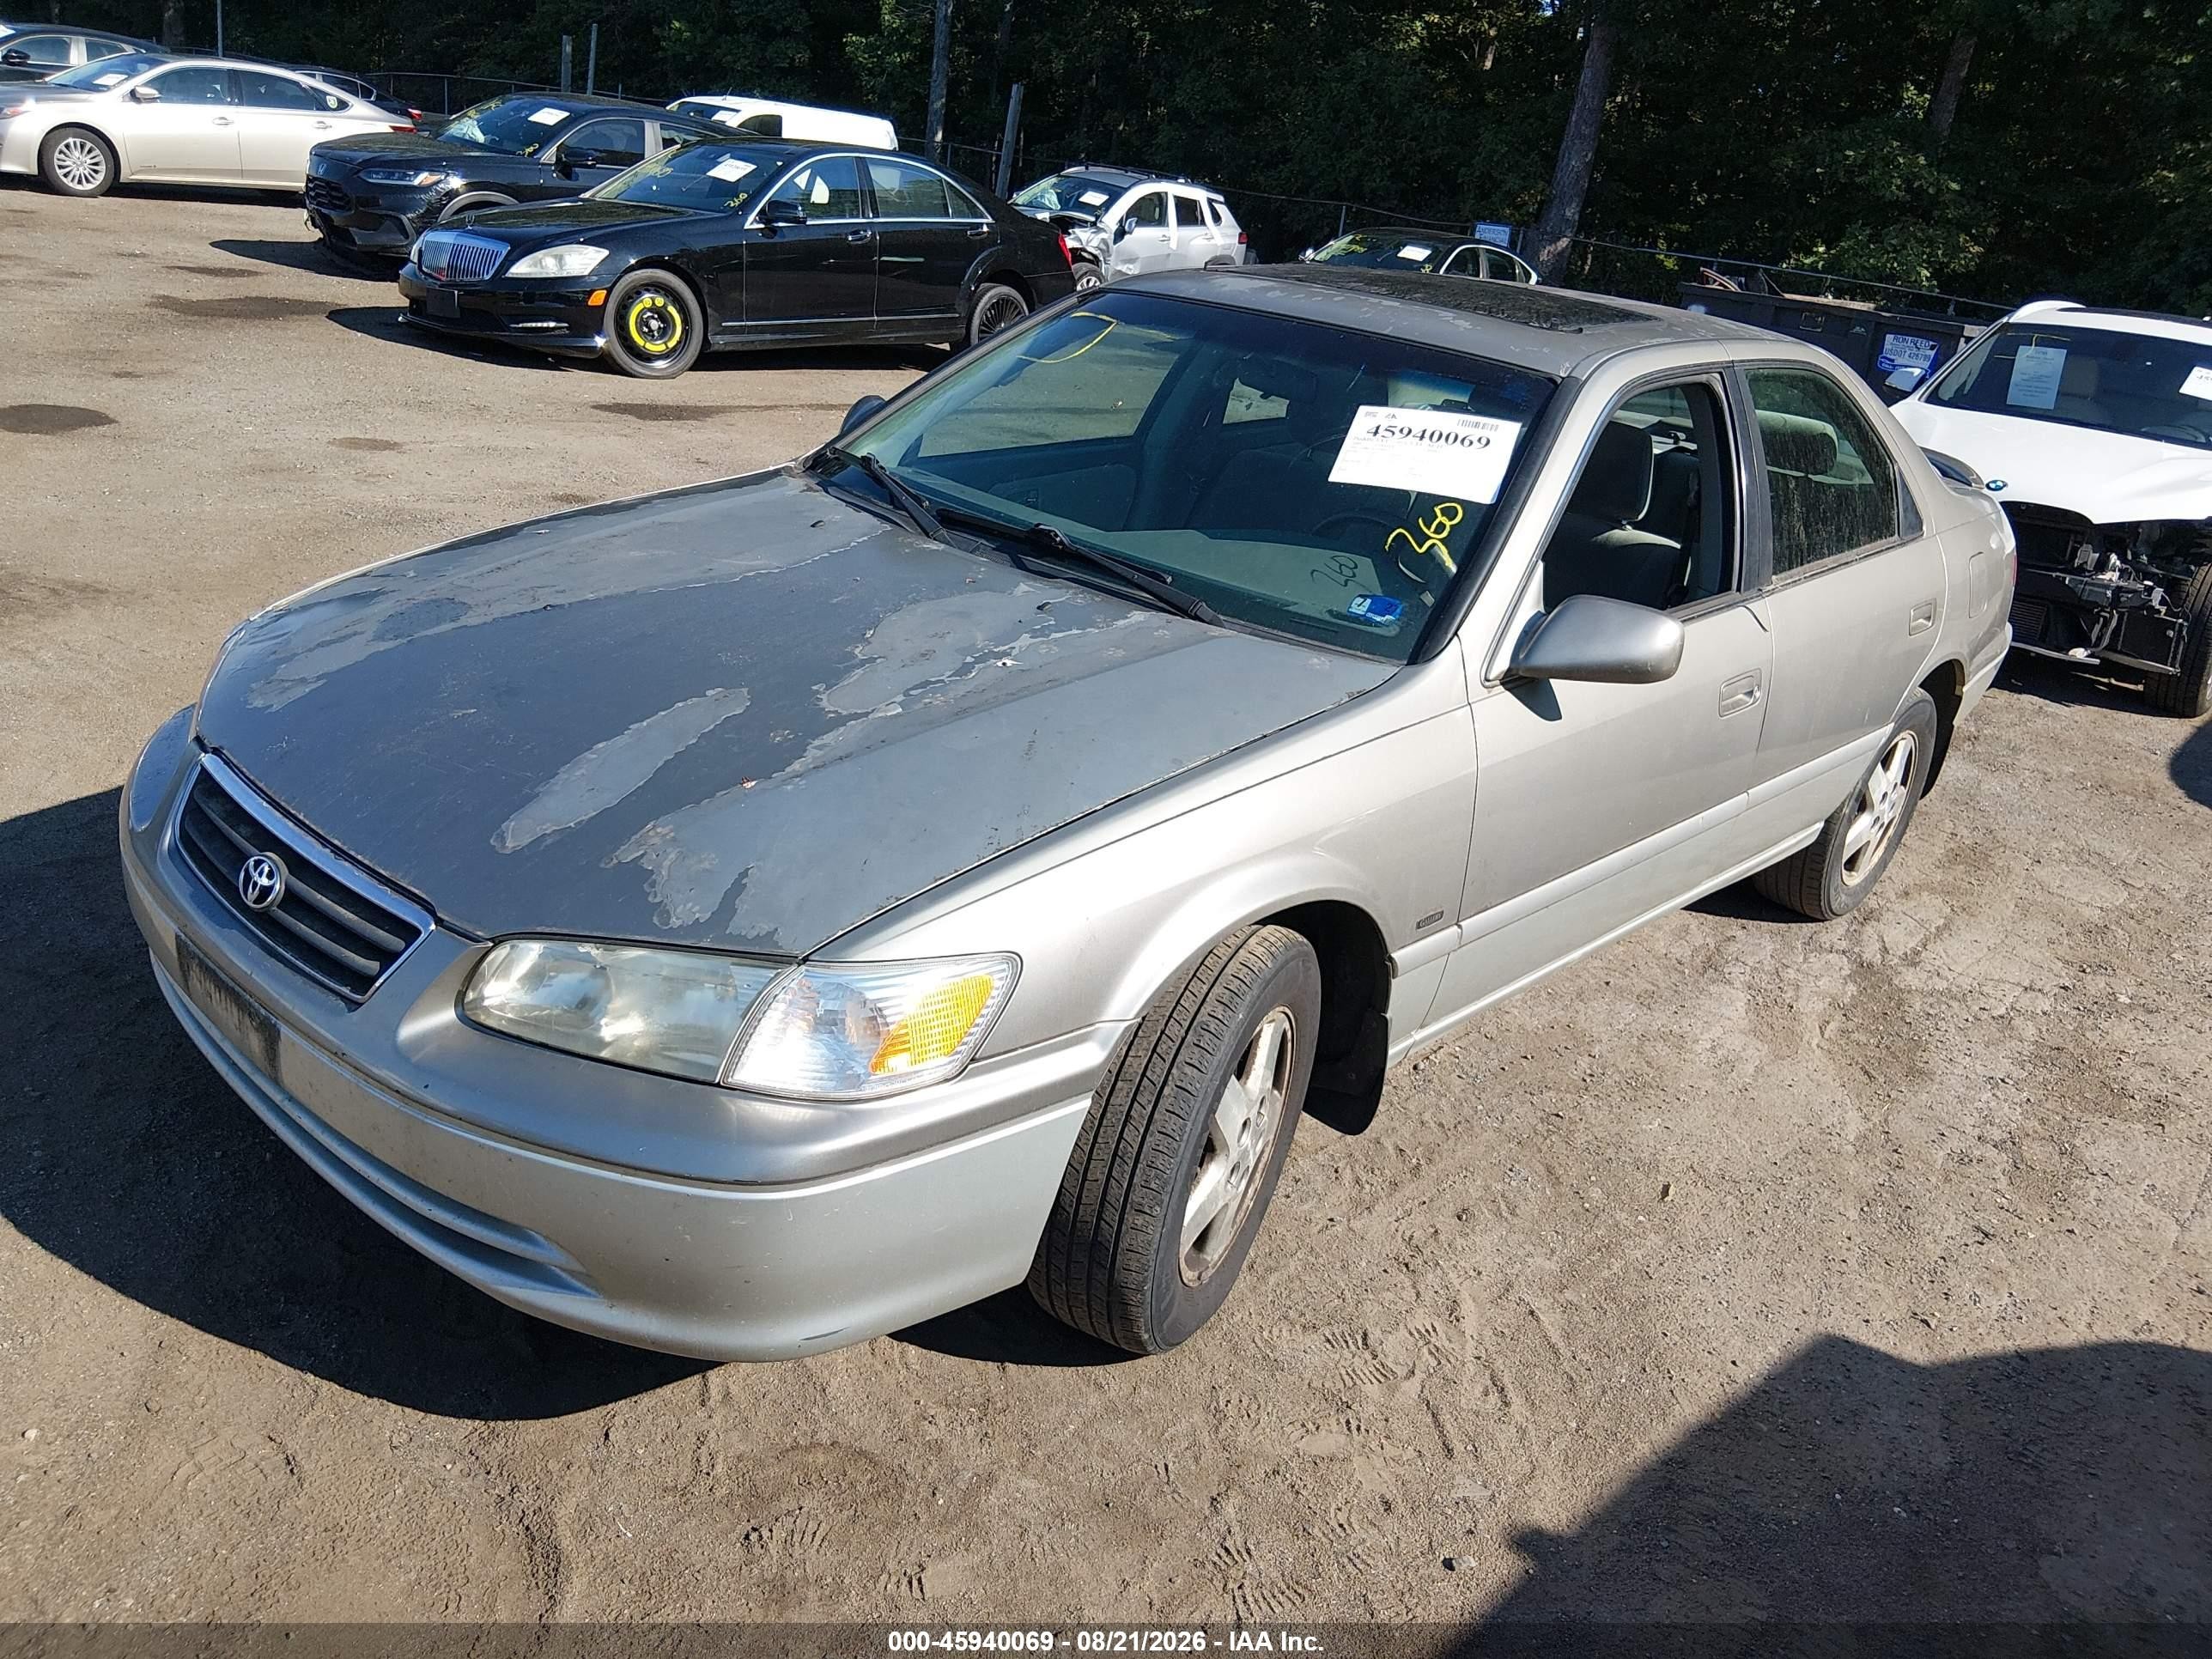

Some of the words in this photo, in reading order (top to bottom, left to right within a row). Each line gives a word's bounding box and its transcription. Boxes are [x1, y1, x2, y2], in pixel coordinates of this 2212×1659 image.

[1893, 335, 1910, 345] RON
[1884, 347, 1906, 358] USDOT
[1366, 423, 1492, 451] 45940069
